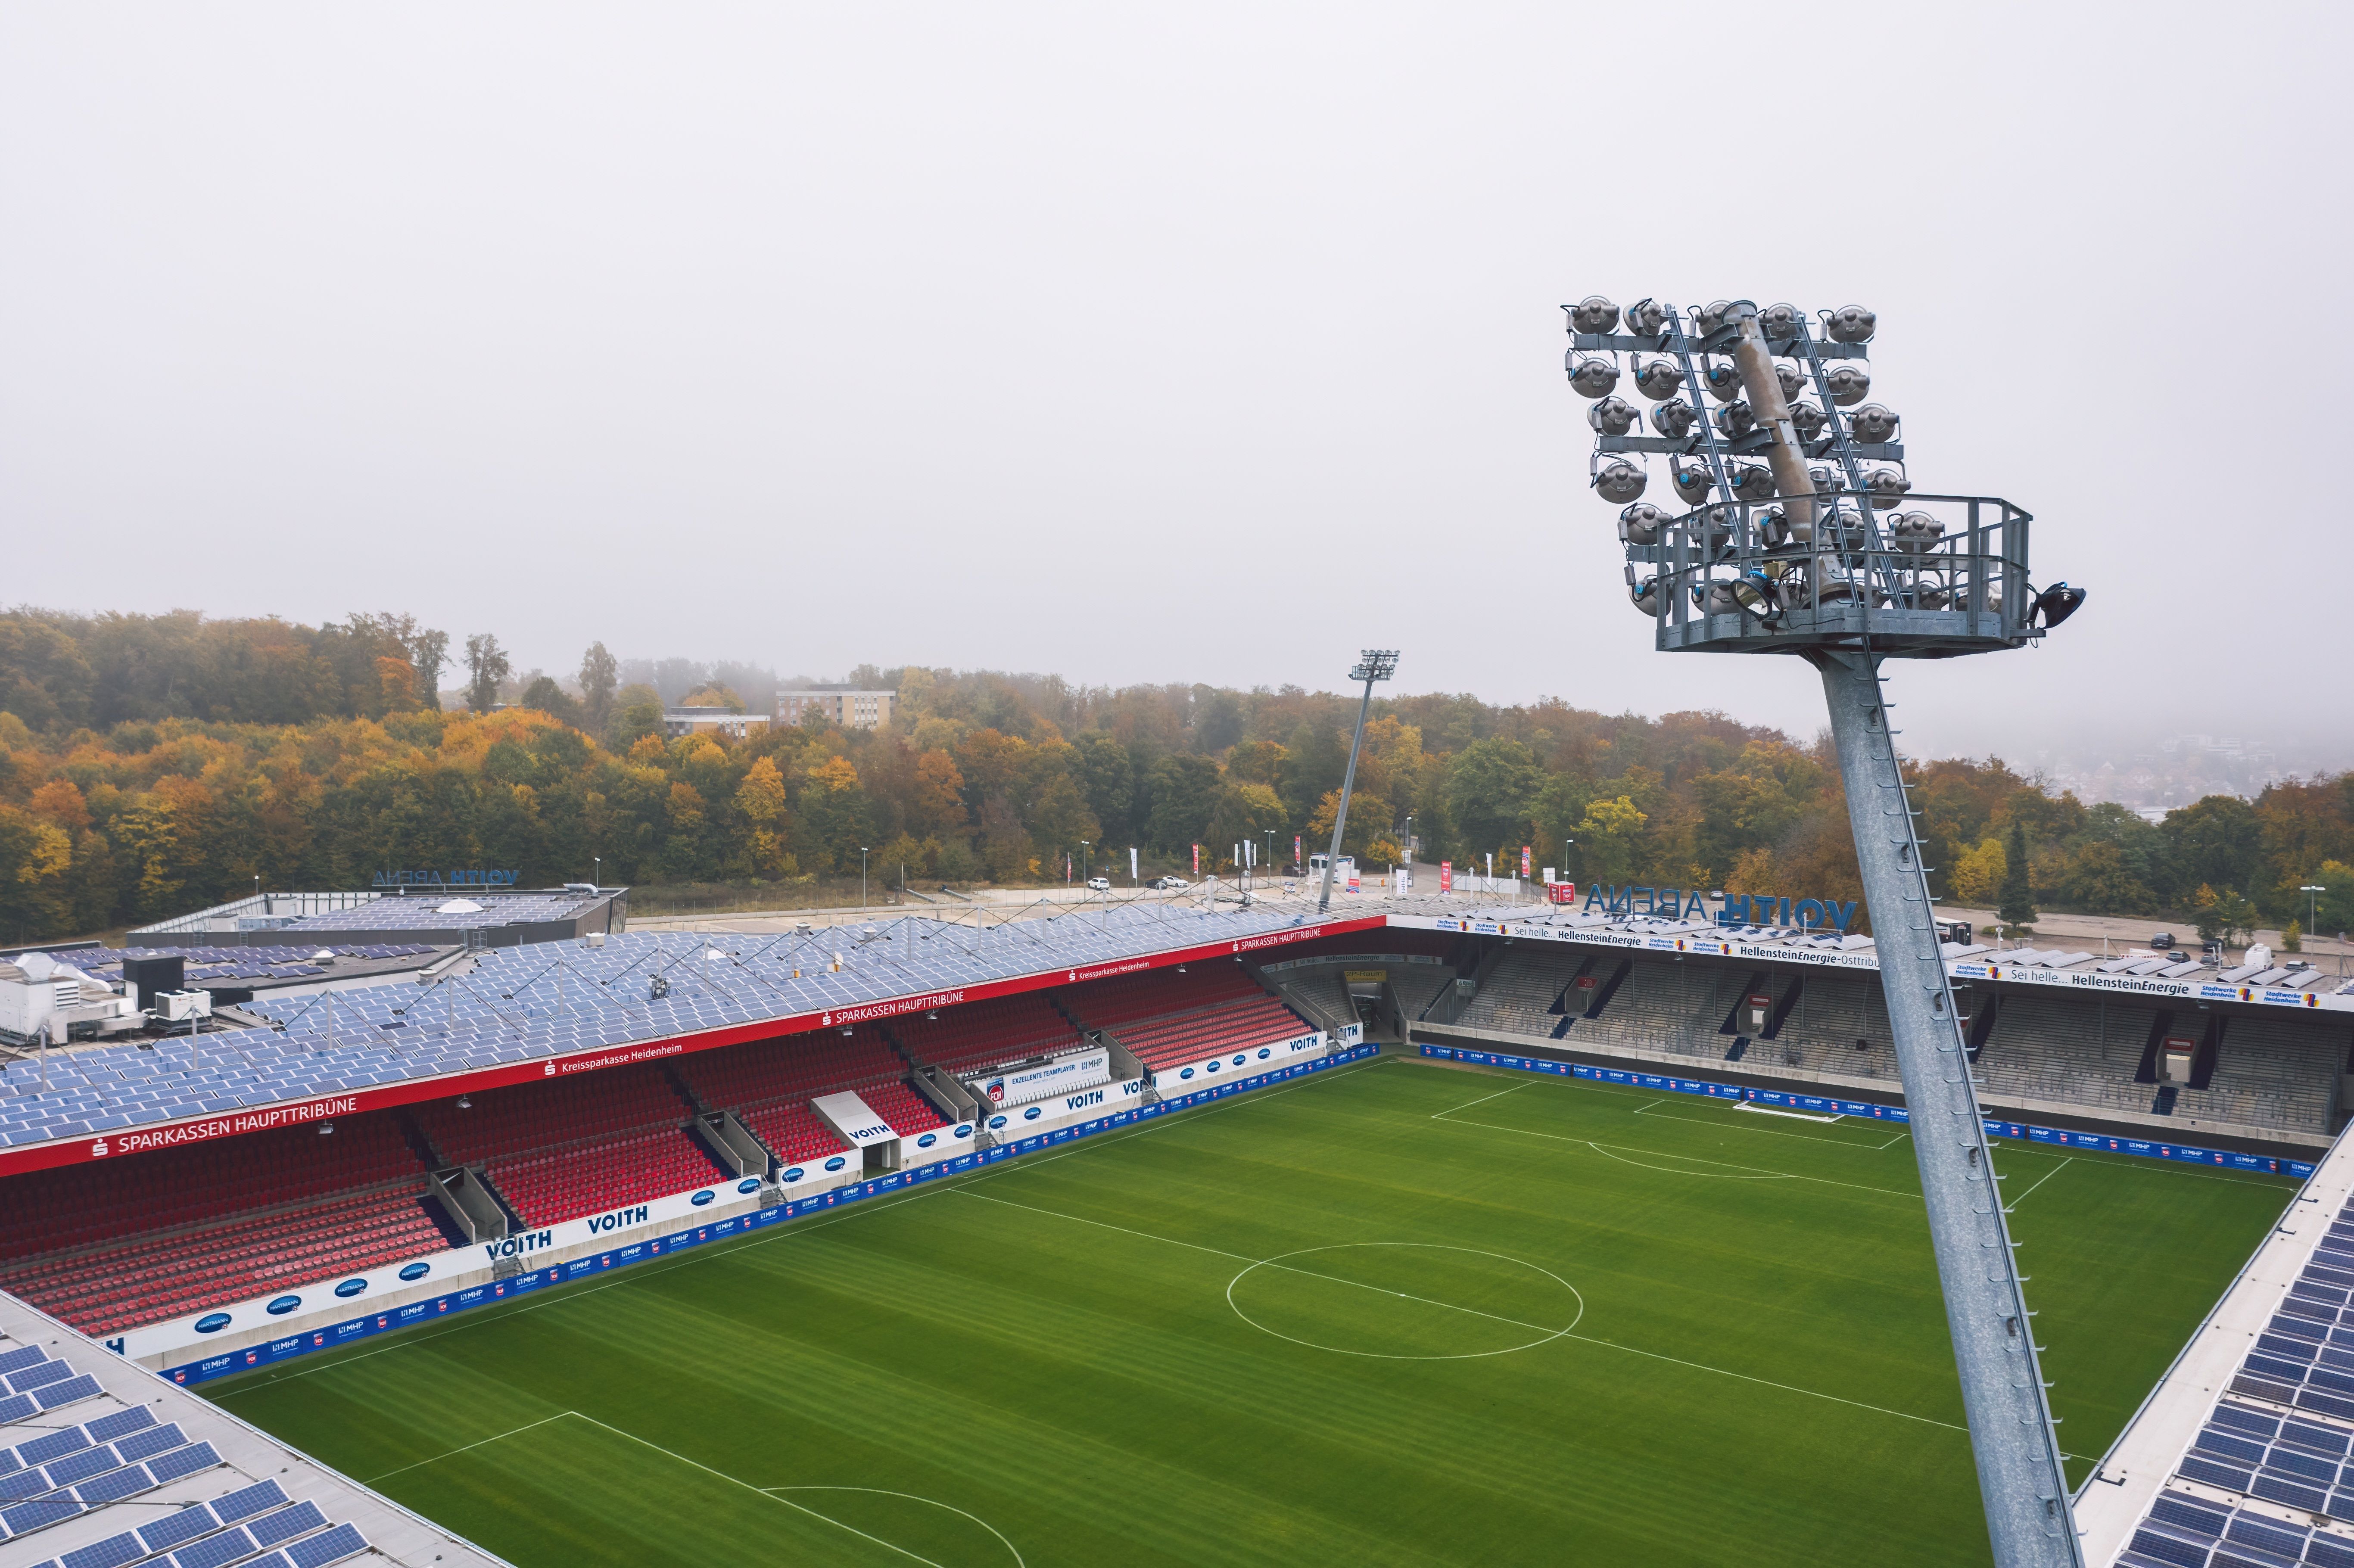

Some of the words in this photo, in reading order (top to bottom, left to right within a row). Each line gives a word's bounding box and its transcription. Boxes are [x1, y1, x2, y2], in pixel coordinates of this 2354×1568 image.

[1241, 937, 1278, 950] SPARKASSEN
[1280, 928, 1320, 944] HAUPTTRIBÜNE
[1515, 927, 1527, 935] Sei
[1529, 927, 1555, 938] helle...
[1558, 931, 1641, 947] HellensteinEnergie
[1079, 968, 1118, 980] Kreissparkasse
[1119, 961, 1149, 973] Heidenheim
[2011, 970, 2027, 980] Sei
[2032, 971, 2068, 983] helle...
[2072, 975, 2189, 995] HellensteinEnergie
[836, 1003, 895, 1024] SPARKASSEN
[898, 991, 964, 1012] HAUPTTRIBÜNE
[1290, 1036, 1317, 1052] VOITH
[562, 1055, 629, 1072] Kreissparkasse
[632, 1044, 682, 1061] Heidenheim
[1089, 1058, 1102, 1068] MHP
[1012, 1072, 1042, 1084] EXZELLENTE
[1043, 1064, 1075, 1077] TEAMPLAYER
[991, 1090, 1001, 1100] FCH
[1067, 1090, 1102, 1110] VOITH
[119, 1120, 230, 1153] SPARKASSEN
[236, 1098, 357, 1134] HAUPTTRIBÜNE
[849, 1125, 890, 1139] VOITH
[693, 1194, 713, 1202] HARTMANN
[588, 1205, 647, 1234] VOITH
[722, 1221, 734, 1229] MHP
[486, 1230, 551, 1260] VOITH
[628, 1247, 641, 1255] MHP
[577, 1260, 591, 1268] MHP
[402, 1267, 427, 1276] HARTMANN
[523, 1275, 538, 1284] MHP
[338, 1283, 364, 1293] HARTMANN
[468, 1289, 483, 1299] MHP
[270, 1300, 298, 1310] HARTMANN
[409, 1305, 424, 1315] MHP
[199, 1317, 228, 1328] HARTMANN
[347, 1322, 363, 1332] MHP
[281, 1339, 299, 1349] MHP
[212, 1358, 230, 1368] MHP
